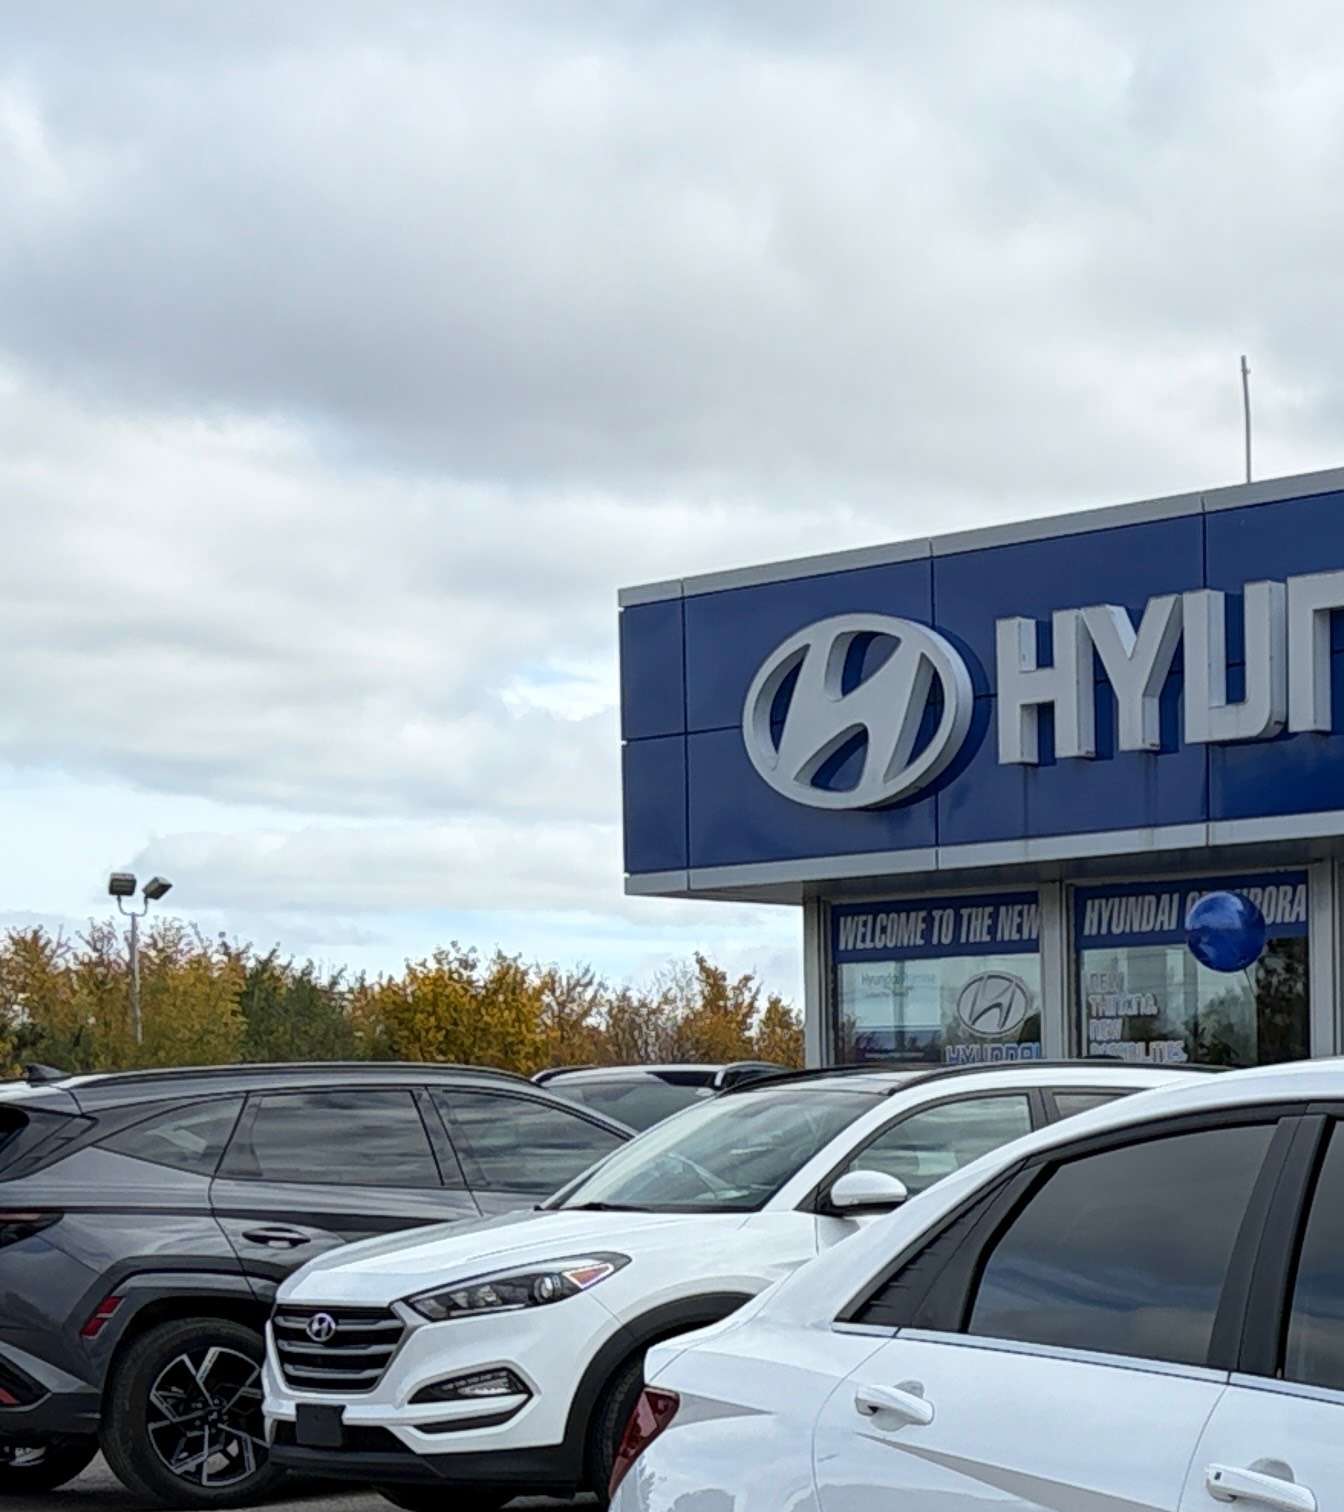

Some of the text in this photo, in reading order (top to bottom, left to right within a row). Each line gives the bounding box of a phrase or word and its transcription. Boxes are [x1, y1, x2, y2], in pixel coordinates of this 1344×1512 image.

[838, 904, 1040, 950] WELCOME TO THE NEW
[1083, 892, 1180, 936] HYUNDAI
